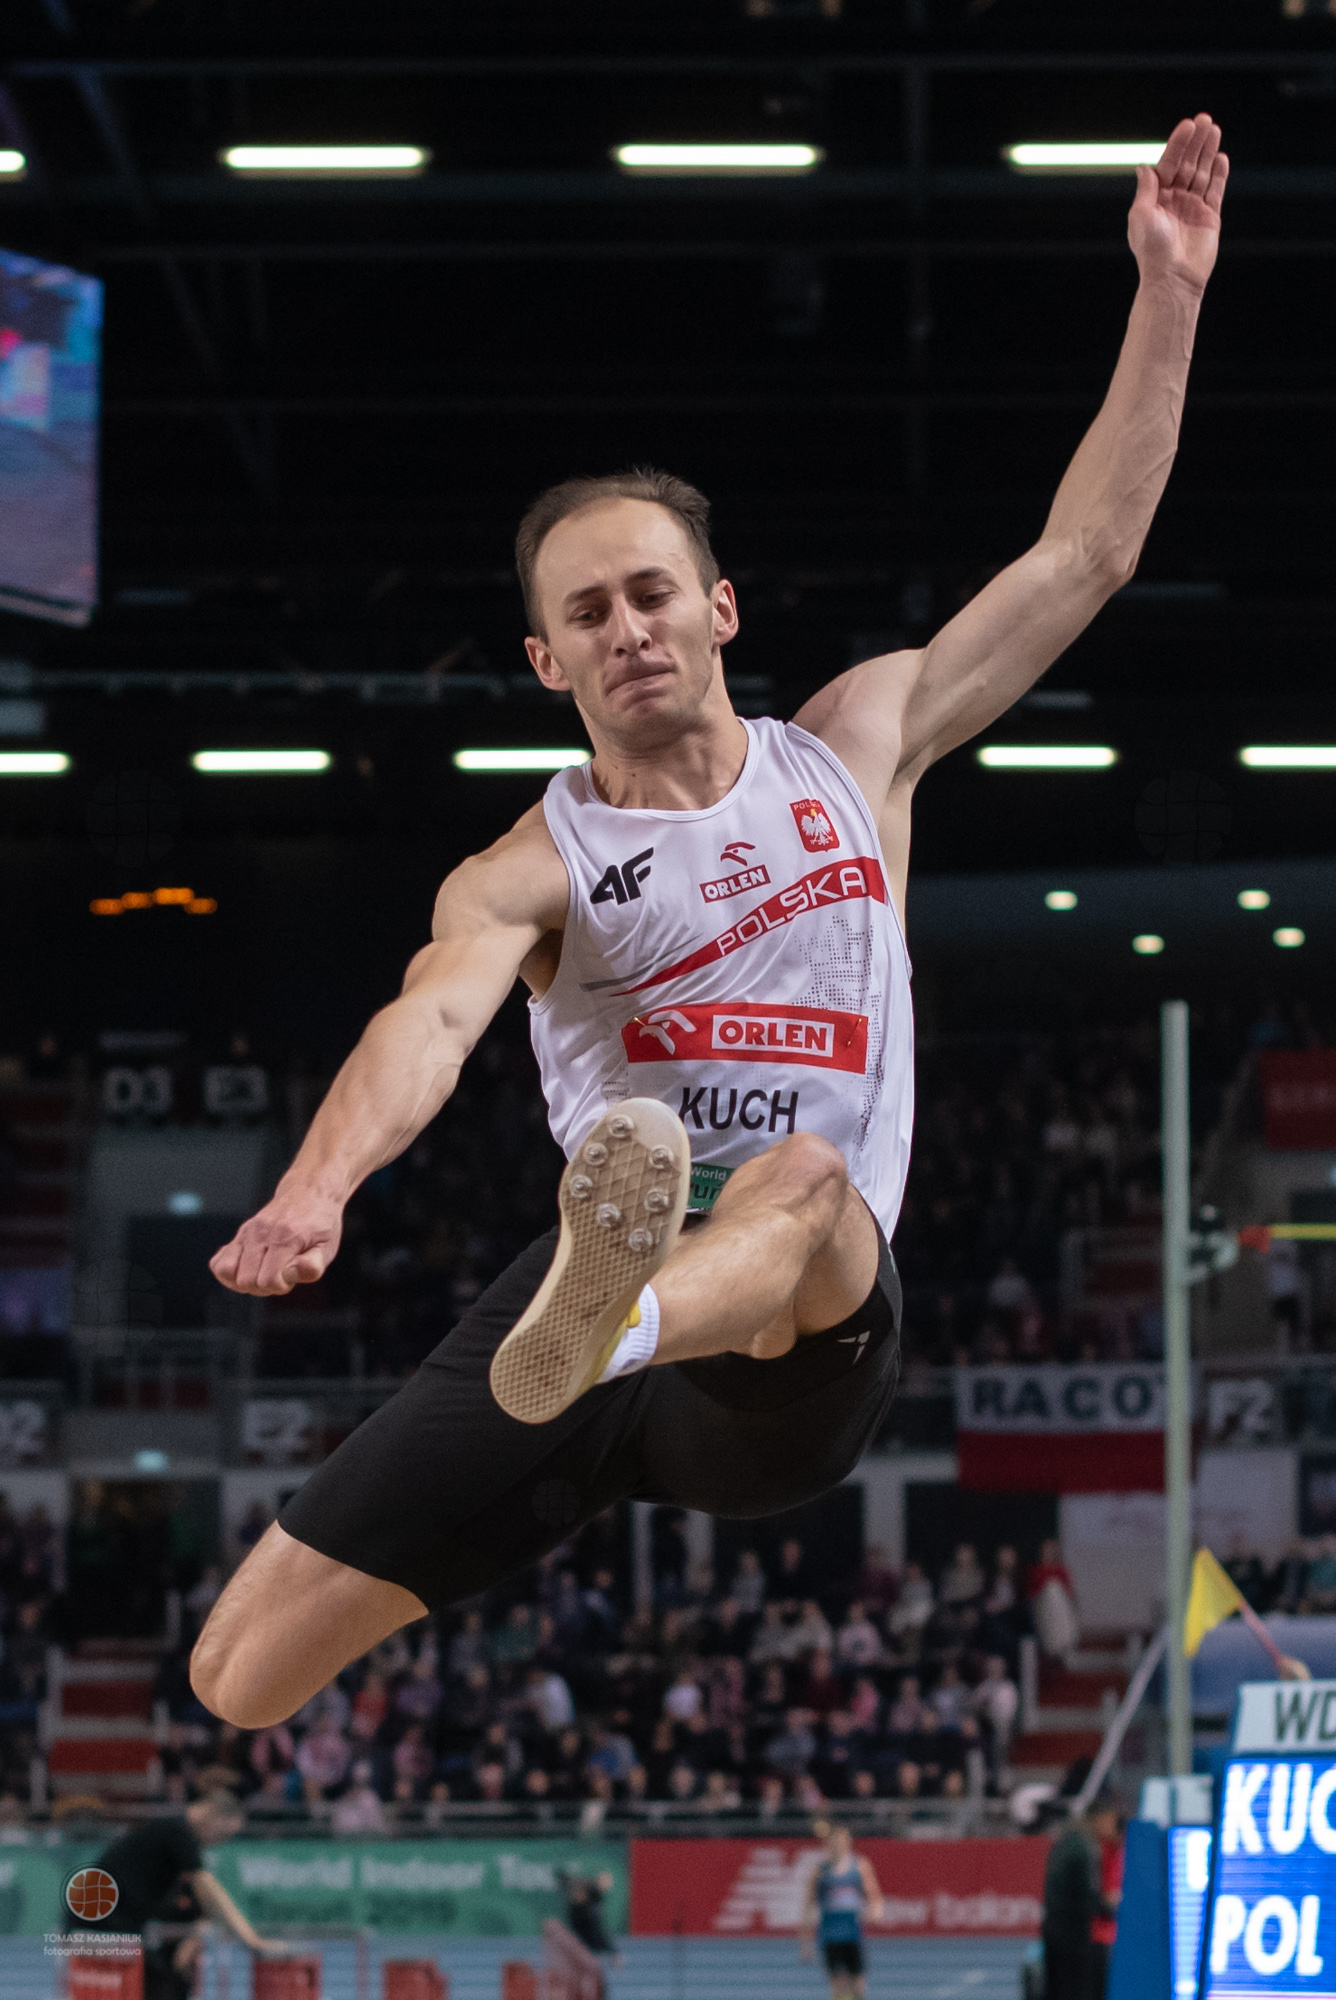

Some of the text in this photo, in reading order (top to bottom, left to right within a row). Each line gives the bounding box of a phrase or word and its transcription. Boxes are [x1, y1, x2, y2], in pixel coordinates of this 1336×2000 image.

[703, 868, 767, 901] ORLEN
[715, 866, 868, 957] POLSKA
[718, 1020, 828, 1051] ORLEN
[679, 1086, 800, 1135] KUCH
[691, 1166, 727, 1181] World
[970, 1377, 1165, 1420] RACO
[1209, 1894, 1324, 1977] POL
